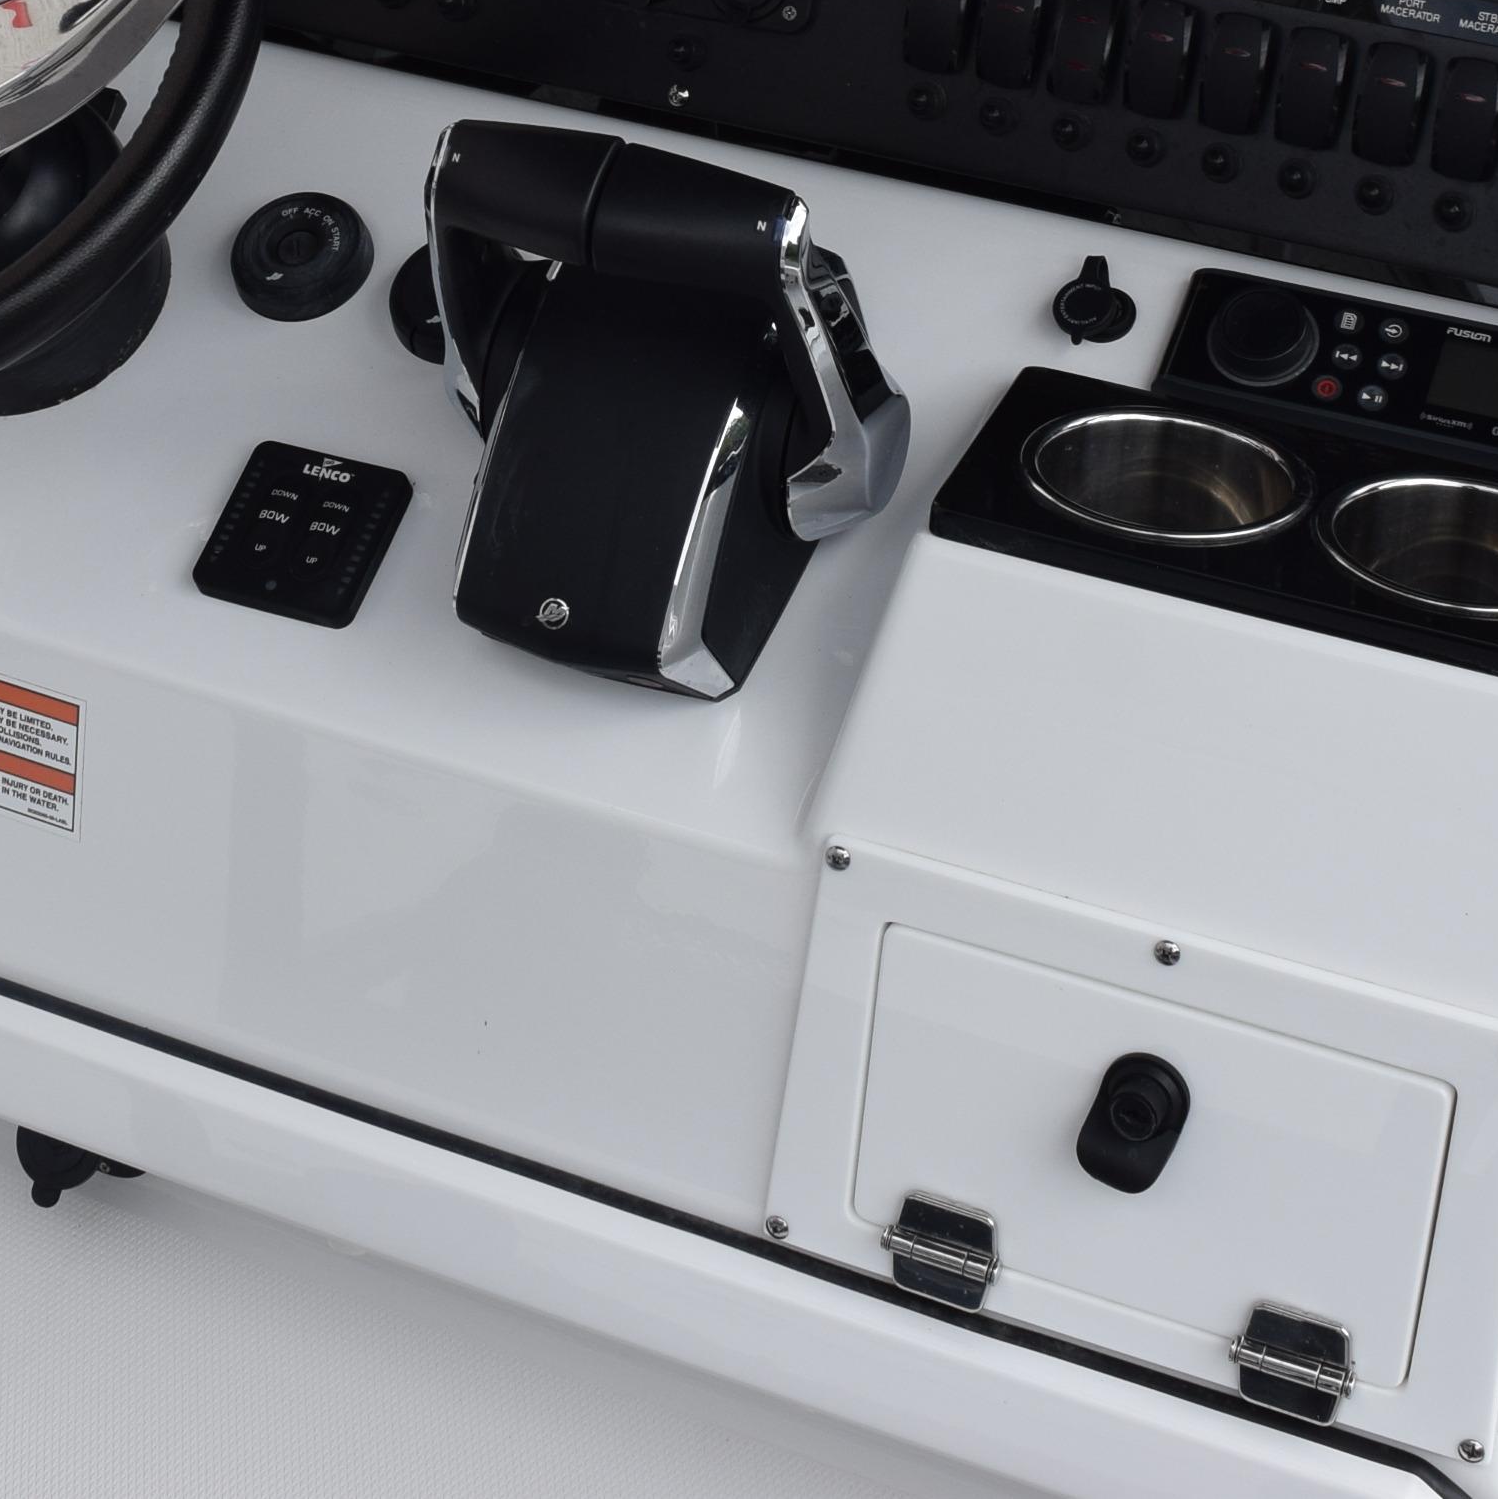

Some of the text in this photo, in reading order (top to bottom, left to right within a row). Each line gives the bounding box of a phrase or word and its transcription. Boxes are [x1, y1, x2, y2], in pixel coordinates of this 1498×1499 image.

[1380, 3, 1441, 24] MACERATOR
[452, 152, 461, 162] N
[281, 207, 299, 217] OFF
[303, 207, 321, 217] ACC
[323, 215, 336, 226] ON
[757, 220, 767, 231] N
[331, 226, 340, 252] START
[1447, 326, 1492, 343] FUSION
[302, 463, 351, 483] LENCO
[271, 488, 298, 501] DOWN
[322, 500, 350, 513] DOWN
[259, 509, 290, 524] BOW
[309, 521, 341, 536] BOW
[255, 543, 266, 552] UP
[306, 556, 318, 564] UP
[7, 709, 17, 718] BE
[20, 713, 53, 731] LIMITED.
[6, 719, 17, 728] BE
[19, 723, 68, 745] NECESSARY.
[0, 735, 43, 756] NAVIGATION
[44, 750, 71, 766] RULES.
[1, 785, 10, 795] IN
[12, 789, 27, 802] THE
[29, 795, 59, 812] WATER.
[2, 777, 28, 791] INJURY
[30, 786, 41, 796] OR
[43, 790, 69, 805] DEATH.
